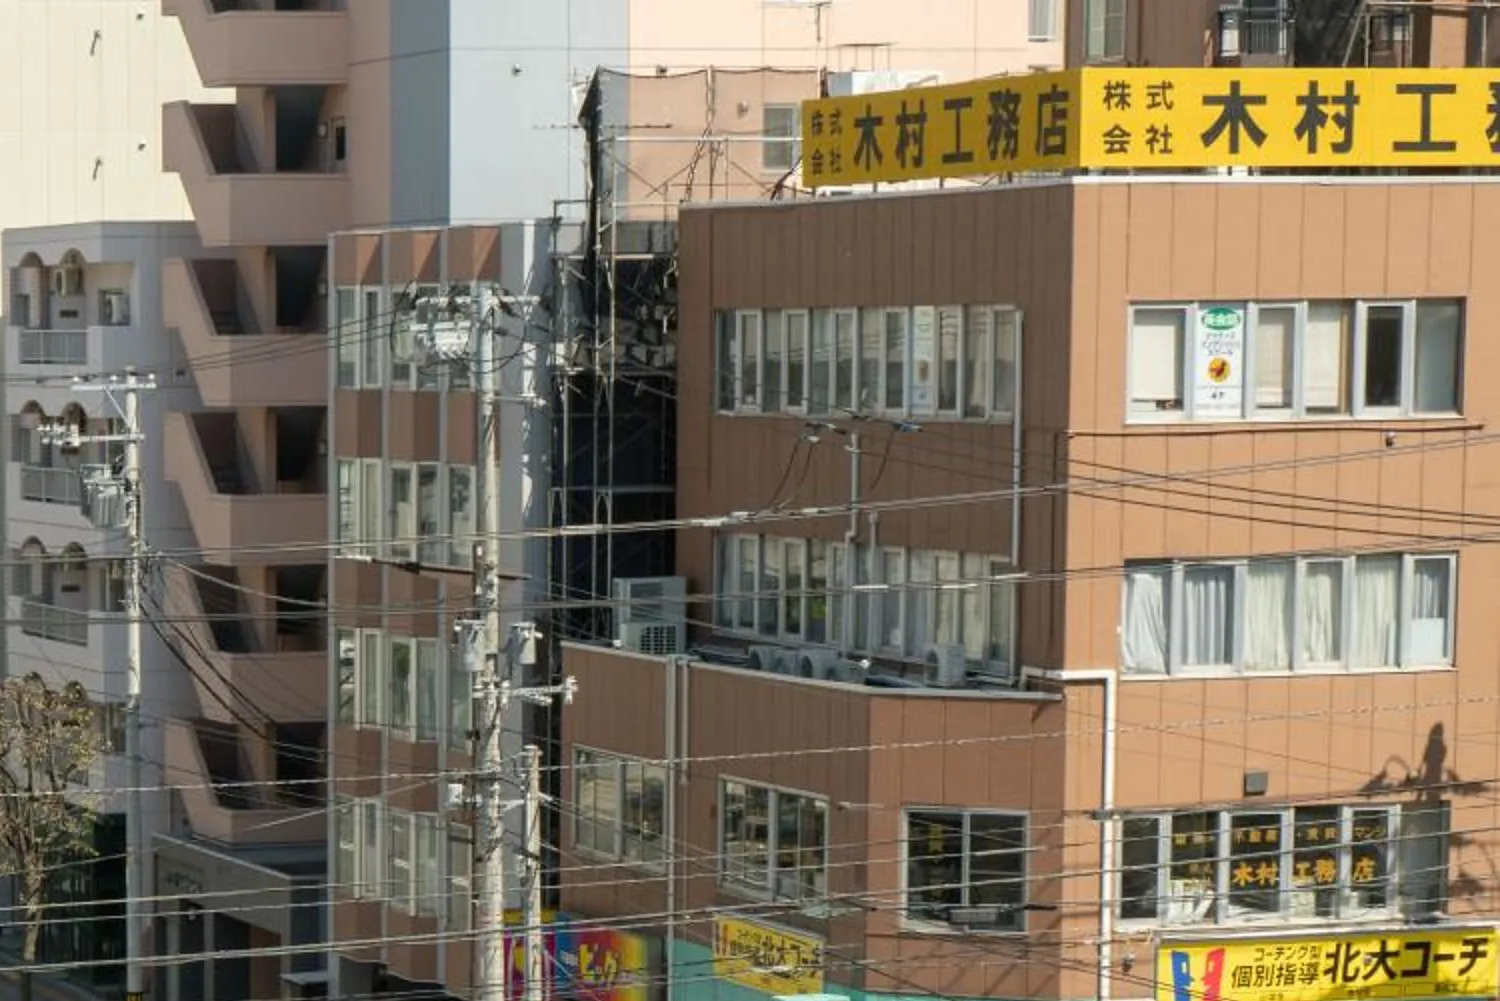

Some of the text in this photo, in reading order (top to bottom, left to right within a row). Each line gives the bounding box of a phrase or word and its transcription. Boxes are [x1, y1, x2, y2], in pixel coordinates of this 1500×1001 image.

[1103, 81, 1175, 112] 株式
[811, 108, 842, 137] 株式
[853, 83, 1070, 172] 木村工務店
[1200, 80, 1500, 155] 木村工
[1102, 124, 1175, 155] 会社
[811, 149, 842, 175] 会社
[1233, 857, 1377, 886] 木村工務店
[1231, 961, 1320, 989] 個別指導
